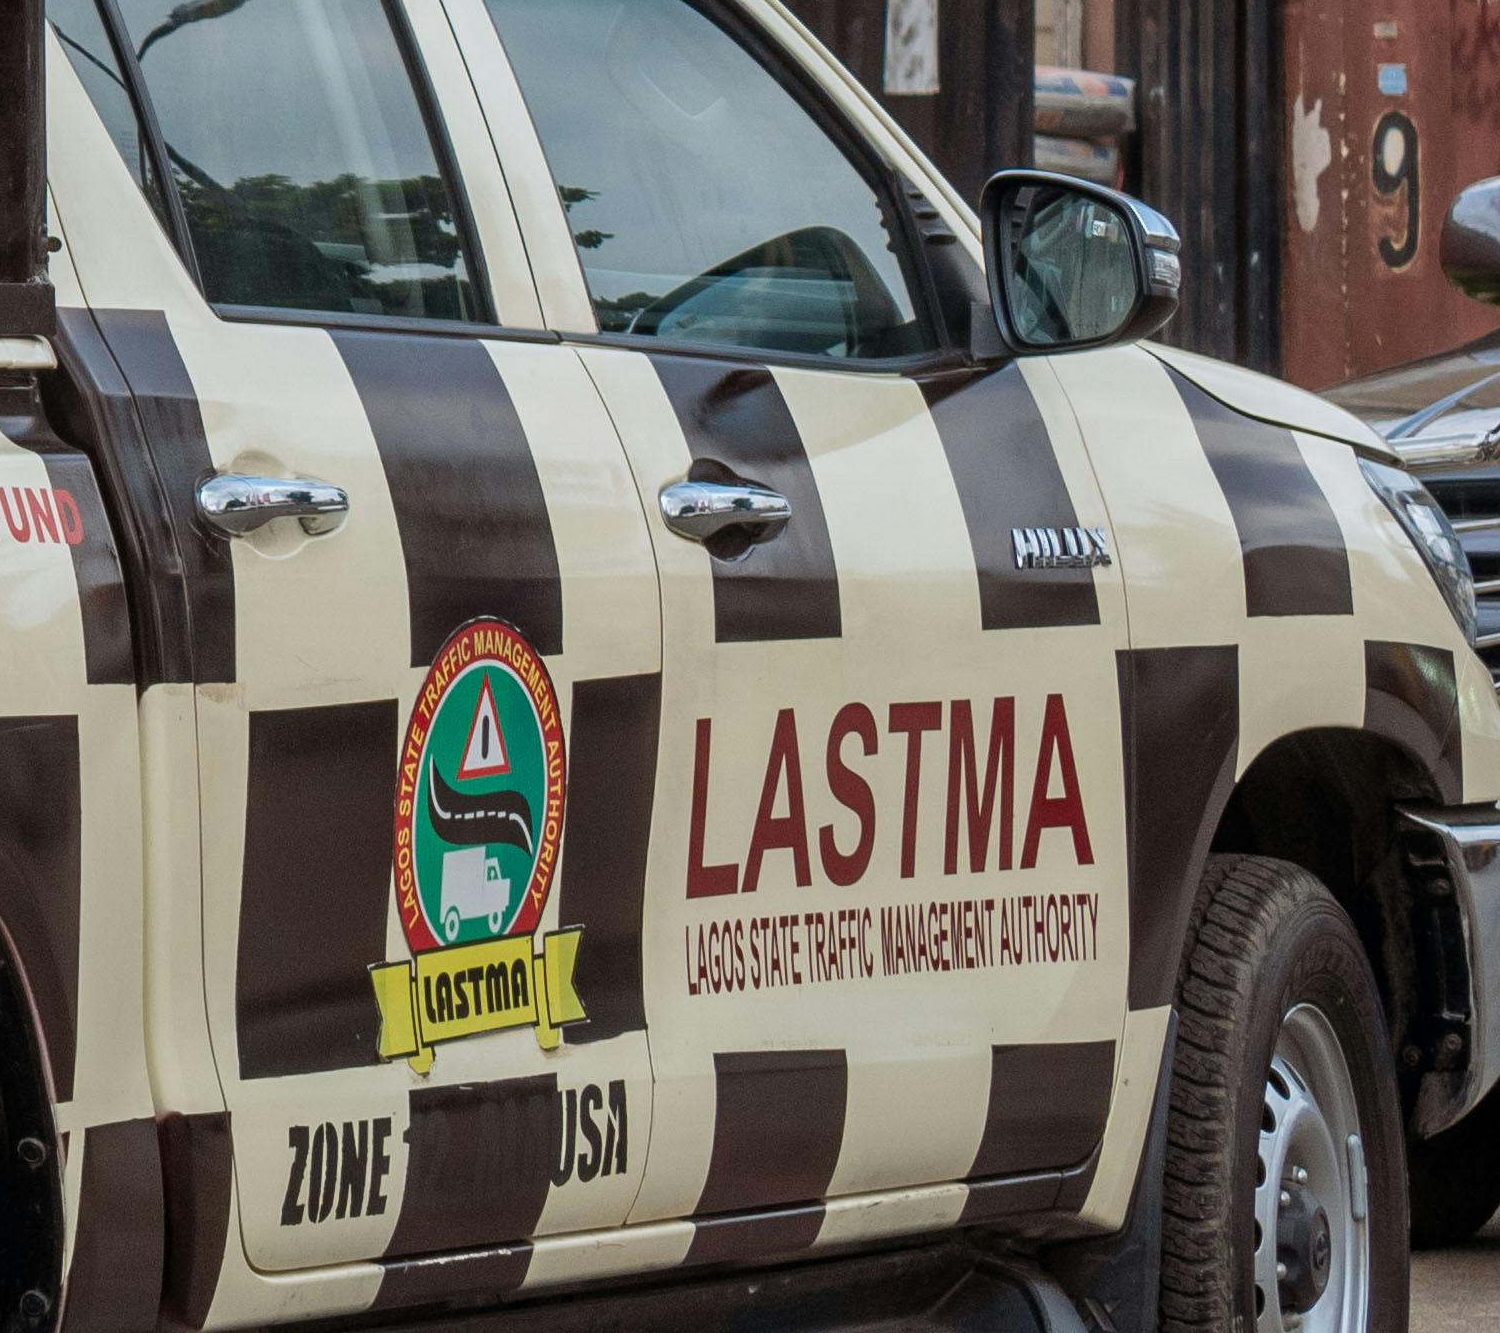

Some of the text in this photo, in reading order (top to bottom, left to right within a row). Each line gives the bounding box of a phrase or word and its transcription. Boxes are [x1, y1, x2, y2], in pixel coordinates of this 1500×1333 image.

[1373, 110, 1420, 268] 9
[397, 630, 562, 929] LAGOS STATE TRAFFIC MANAGEMENT AUTHORITY
[685, 693, 1096, 900] LASTMA
[423, 957, 530, 1024] LASTMA
[685, 893, 1099, 996] LAGOS STATE TRAFFIC MANAGEMENT AUTHORITY
[280, 1116, 392, 1227] ZONE
